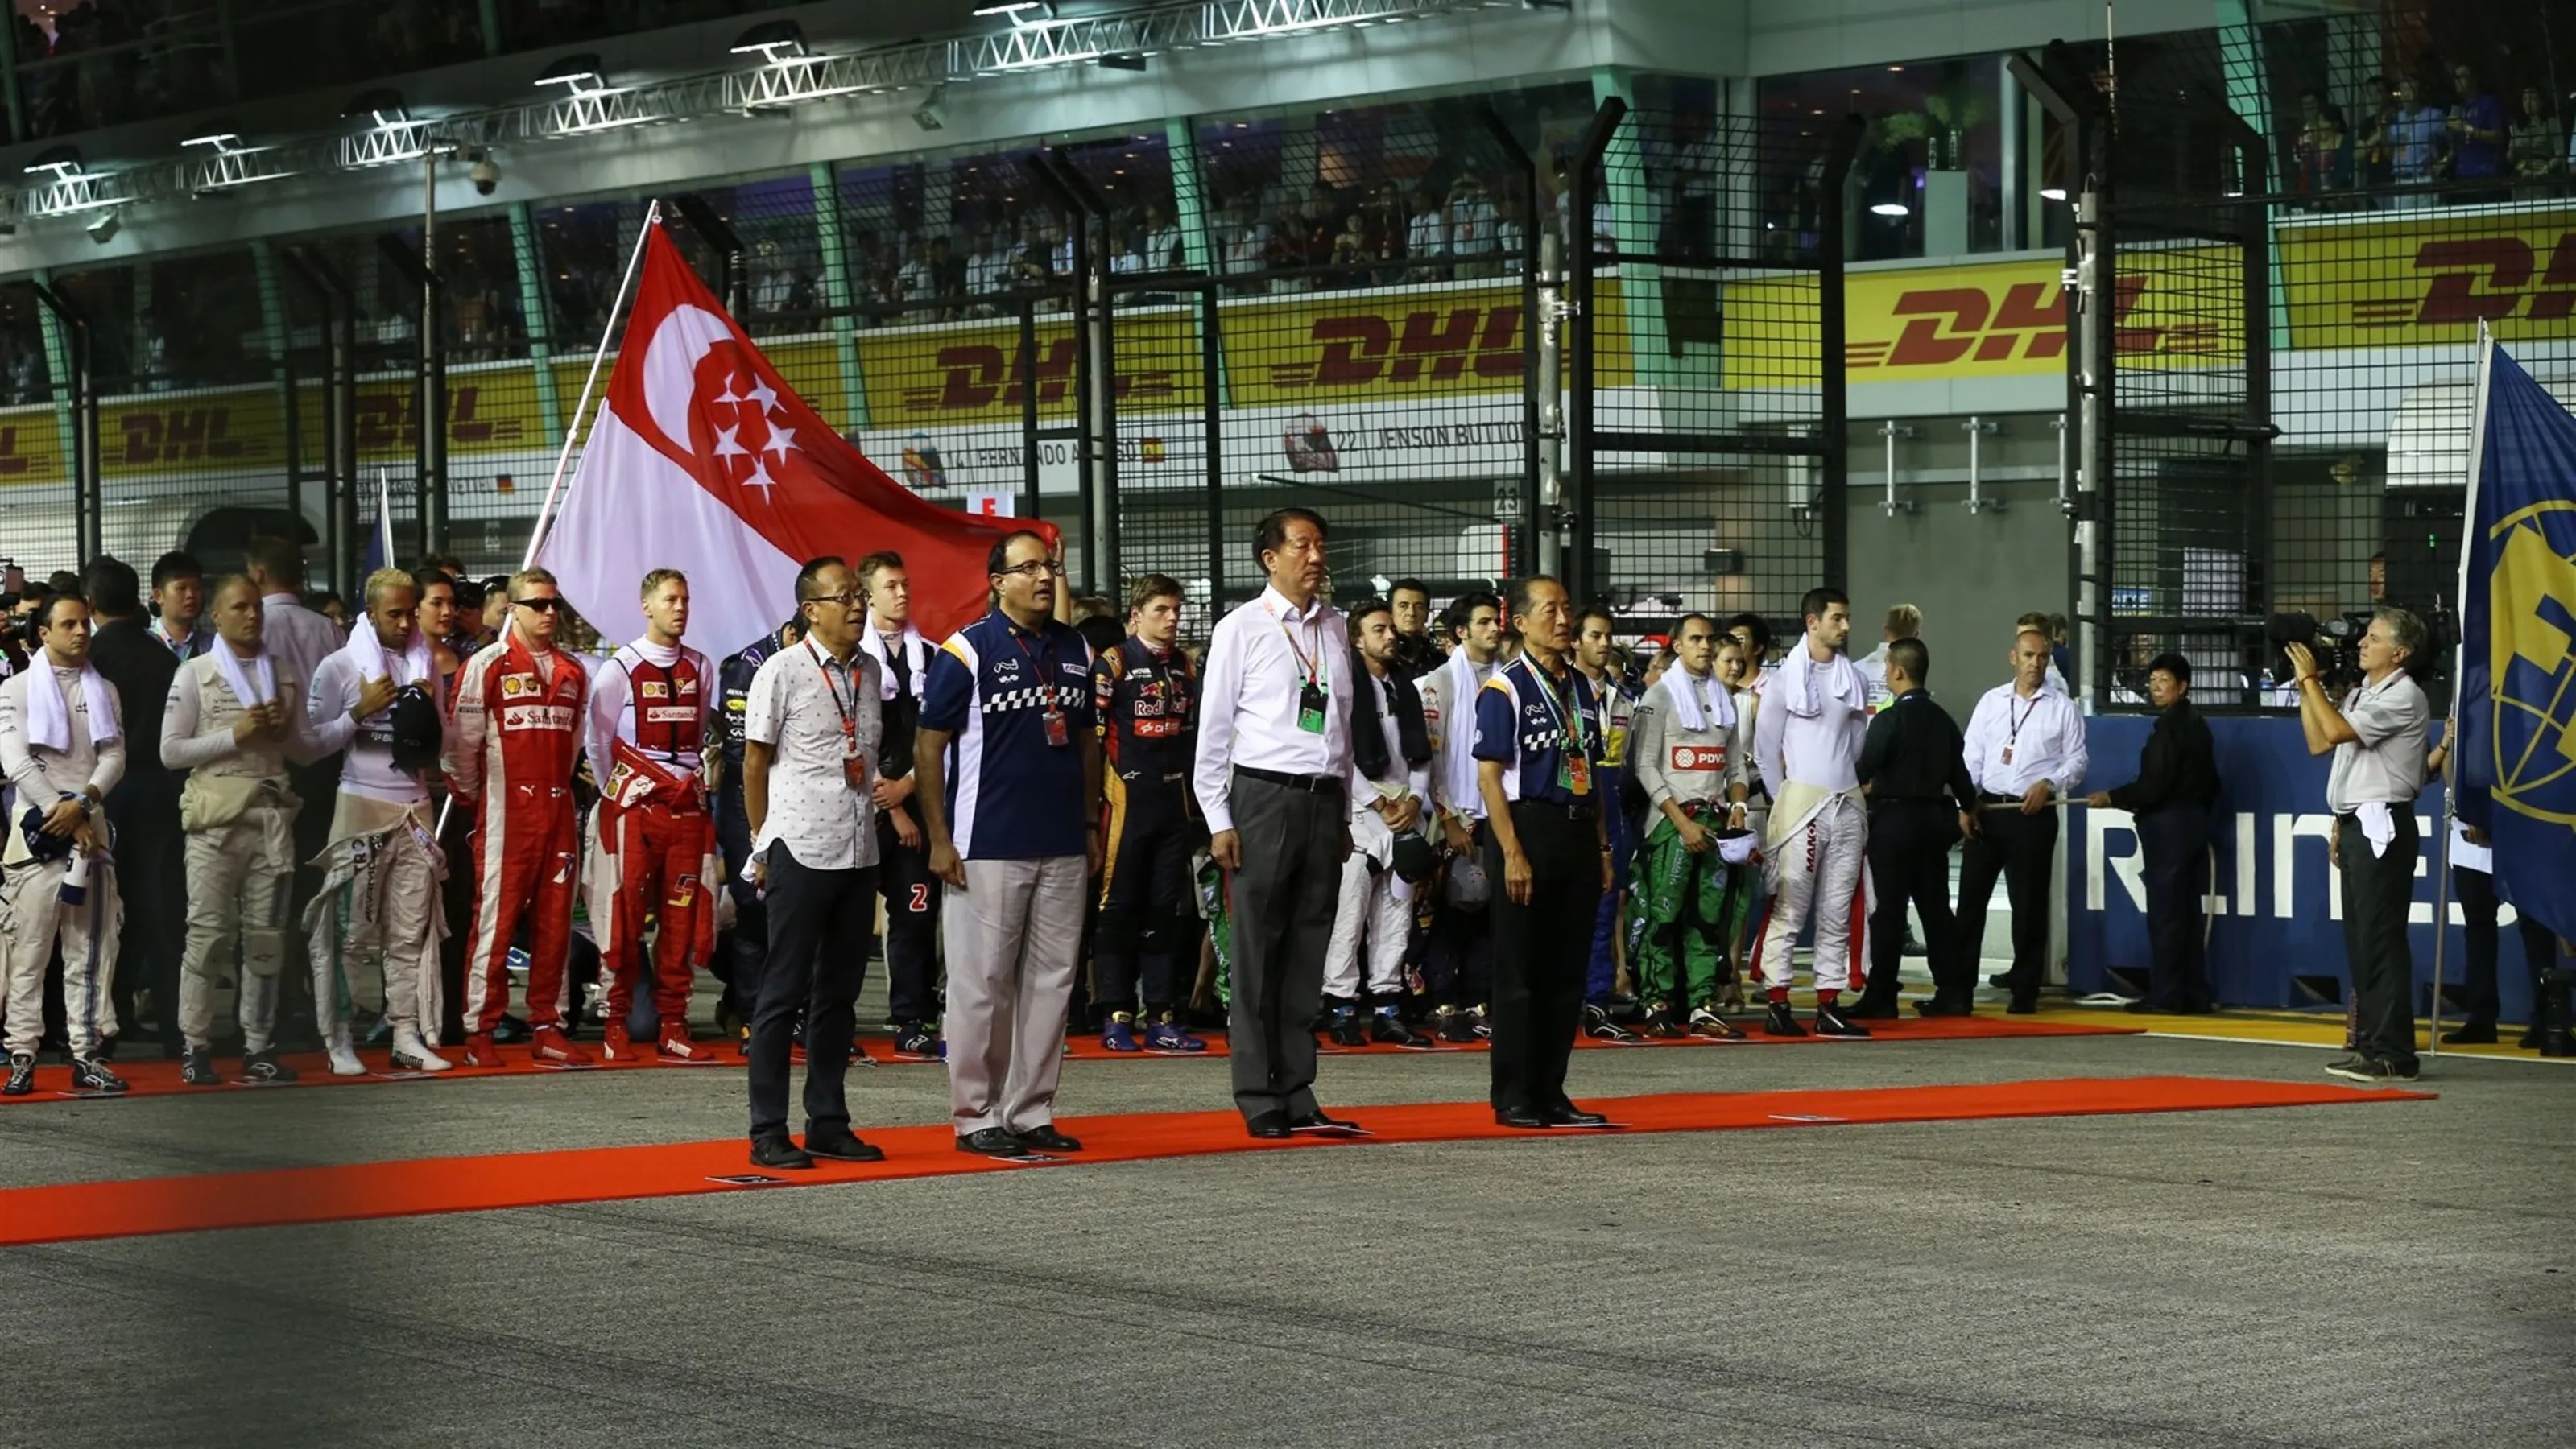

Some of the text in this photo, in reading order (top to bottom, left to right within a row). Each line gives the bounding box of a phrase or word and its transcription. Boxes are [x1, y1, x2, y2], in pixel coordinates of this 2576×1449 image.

[1311, 305, 1540, 386] DHL
[121, 407, 244, 464] DHL
[1376, 426, 1449, 450] JENSON
[1454, 421, 1524, 446] BUTTO
[979, 444, 1066, 468] FERNNDO
[1496, 487, 1518, 511] 23
[552, 852, 575, 884] 7
[909, 883, 928, 912] 2
